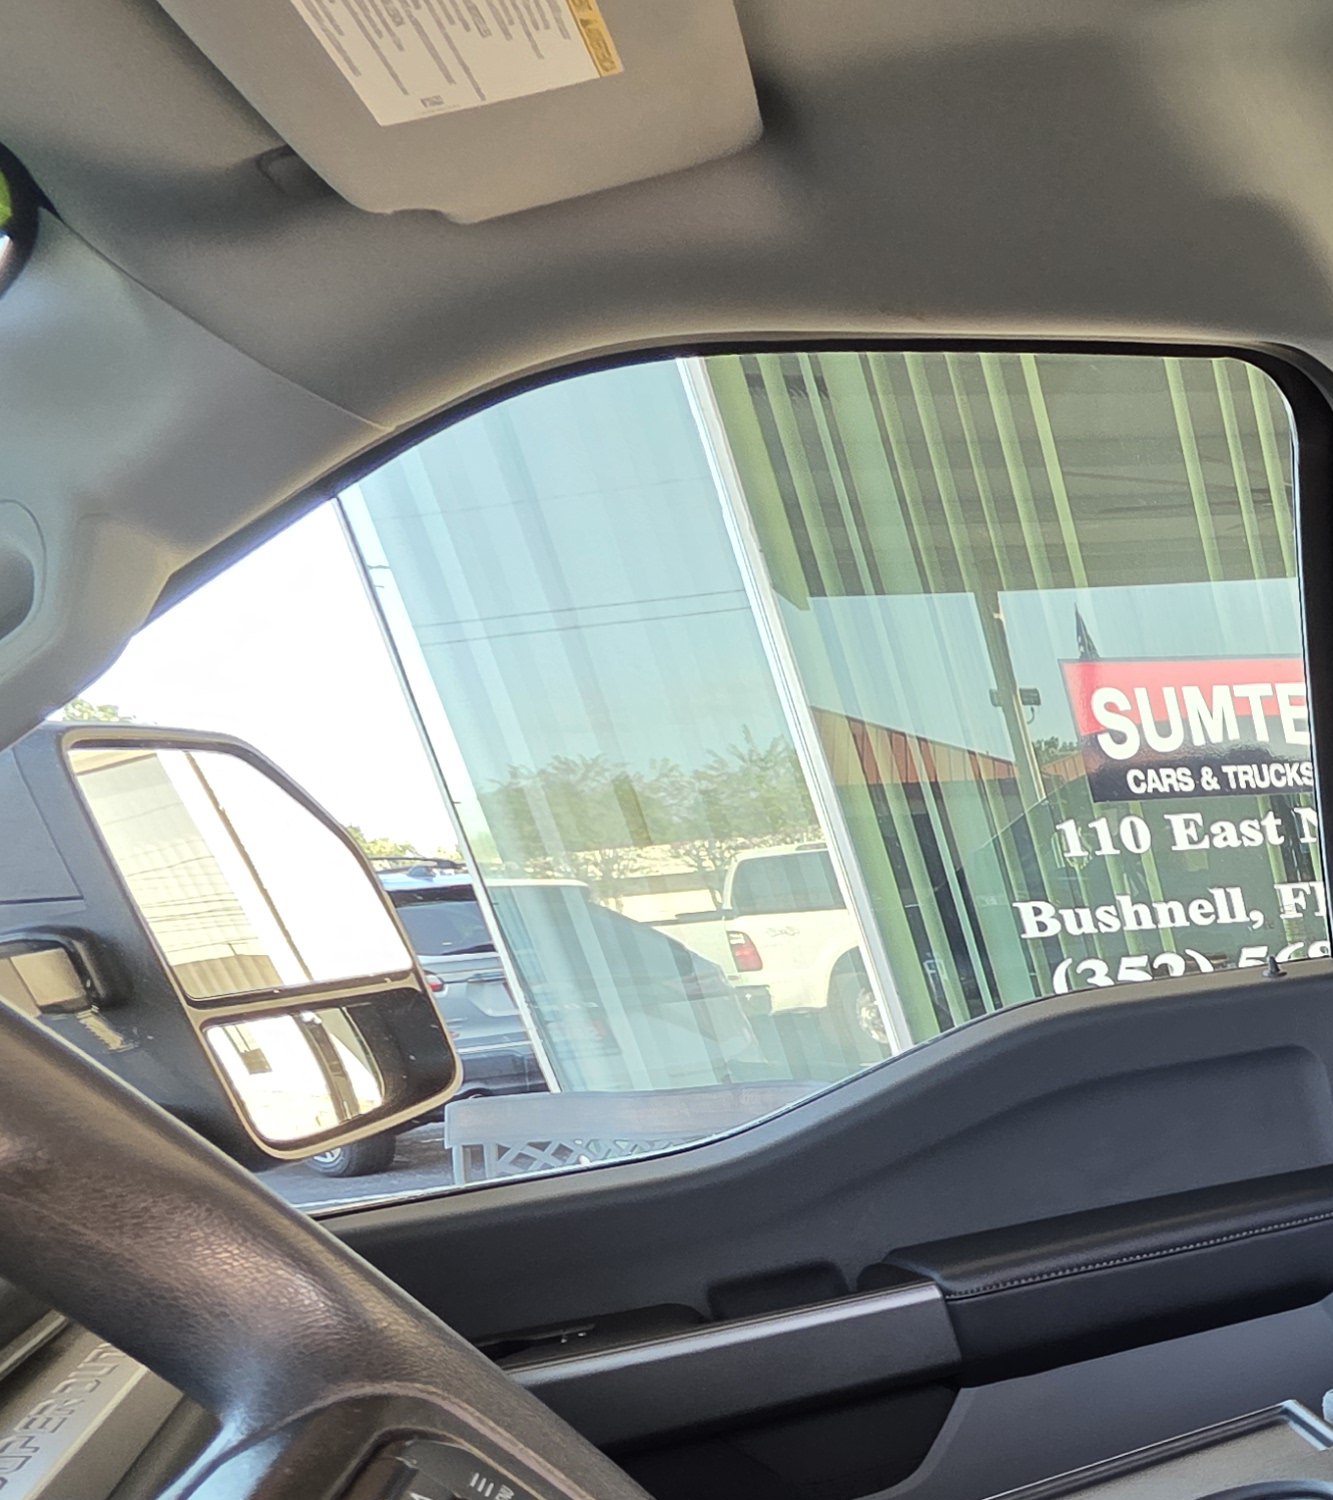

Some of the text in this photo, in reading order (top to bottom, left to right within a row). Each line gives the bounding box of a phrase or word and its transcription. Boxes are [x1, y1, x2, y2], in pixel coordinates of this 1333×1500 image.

[1126, 762, 1313, 794] CARS & TRUCKS
[1056, 814, 1152, 859] 110
[1163, 810, 1285, 851] East
[1012, 886, 1265, 939] Bushnell,
